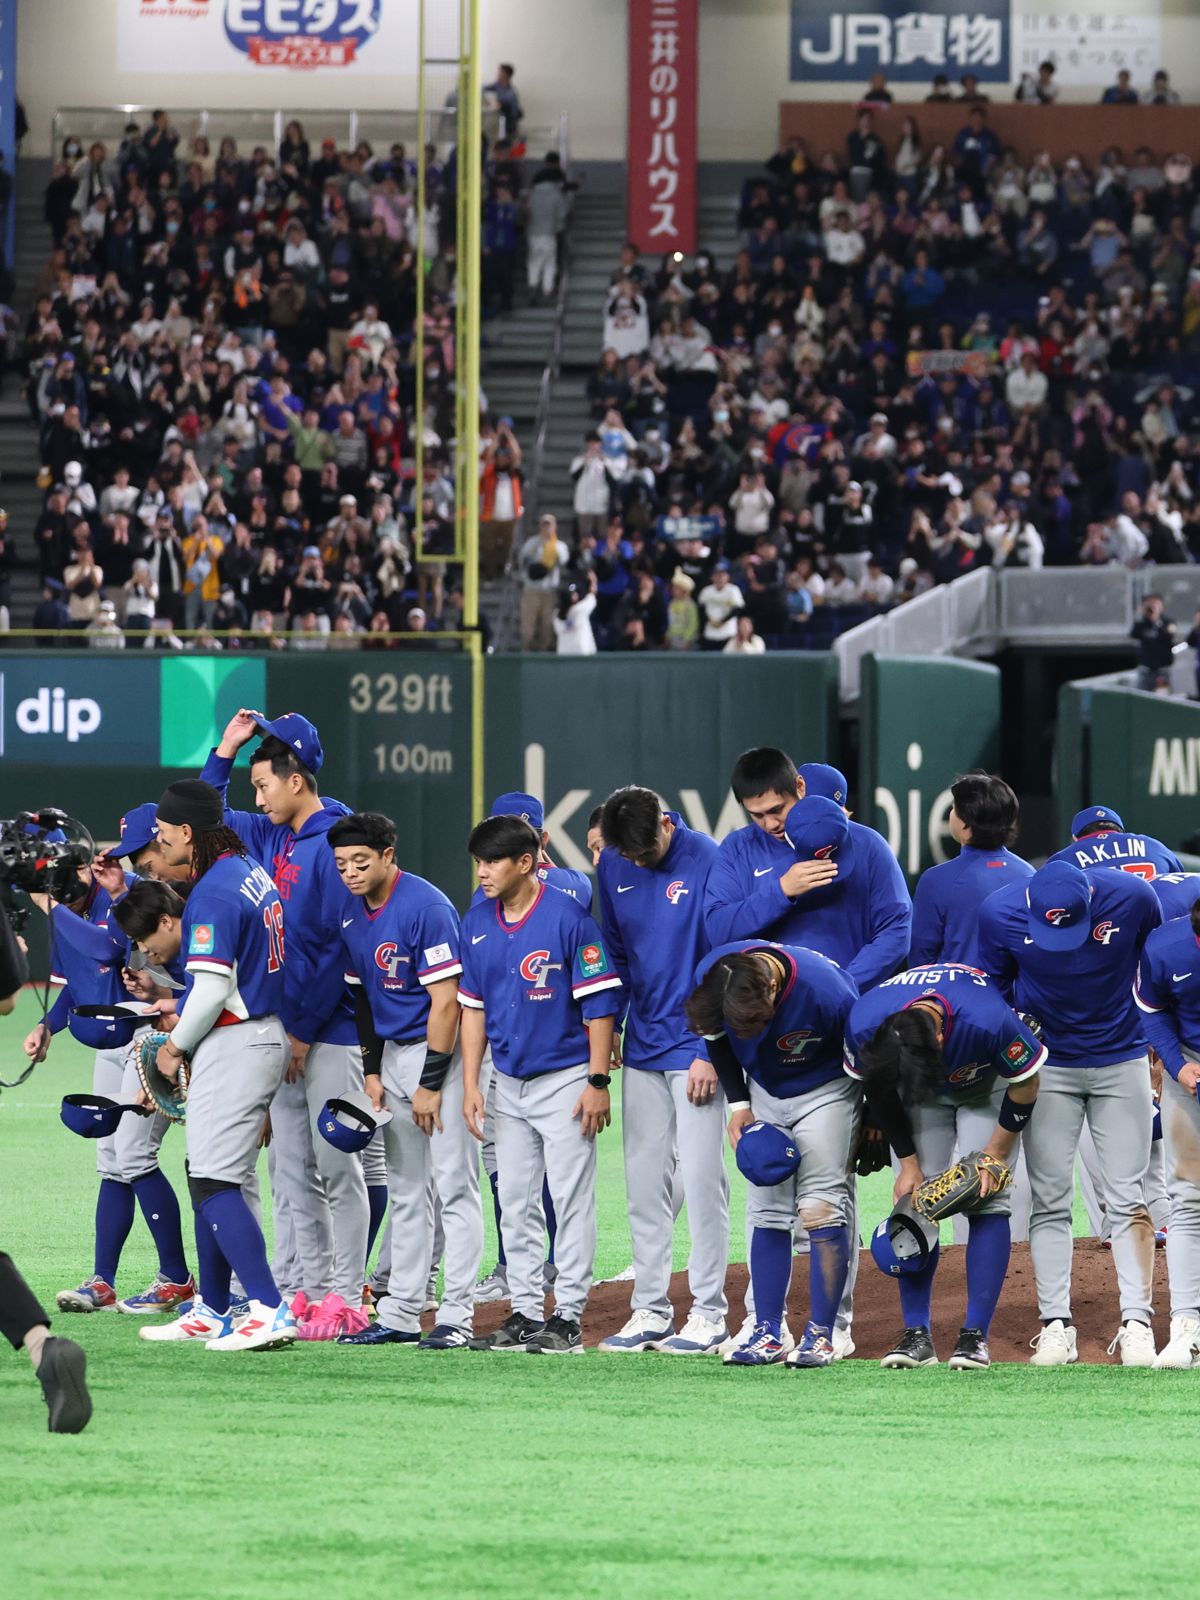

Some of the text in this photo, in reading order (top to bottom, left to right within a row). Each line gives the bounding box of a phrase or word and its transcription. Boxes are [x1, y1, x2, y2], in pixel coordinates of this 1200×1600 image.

[799, 12, 1003, 66] JR貨物
[648, 0, 679, 237] 三井のリハウス
[349, 673, 453, 713] 329ft
[16, 687, 101, 742] dip
[374, 744, 452, 773] 100m
[1075, 838, 1146, 868] A.K.LIN
[529, 991, 552, 1000] Taipei
